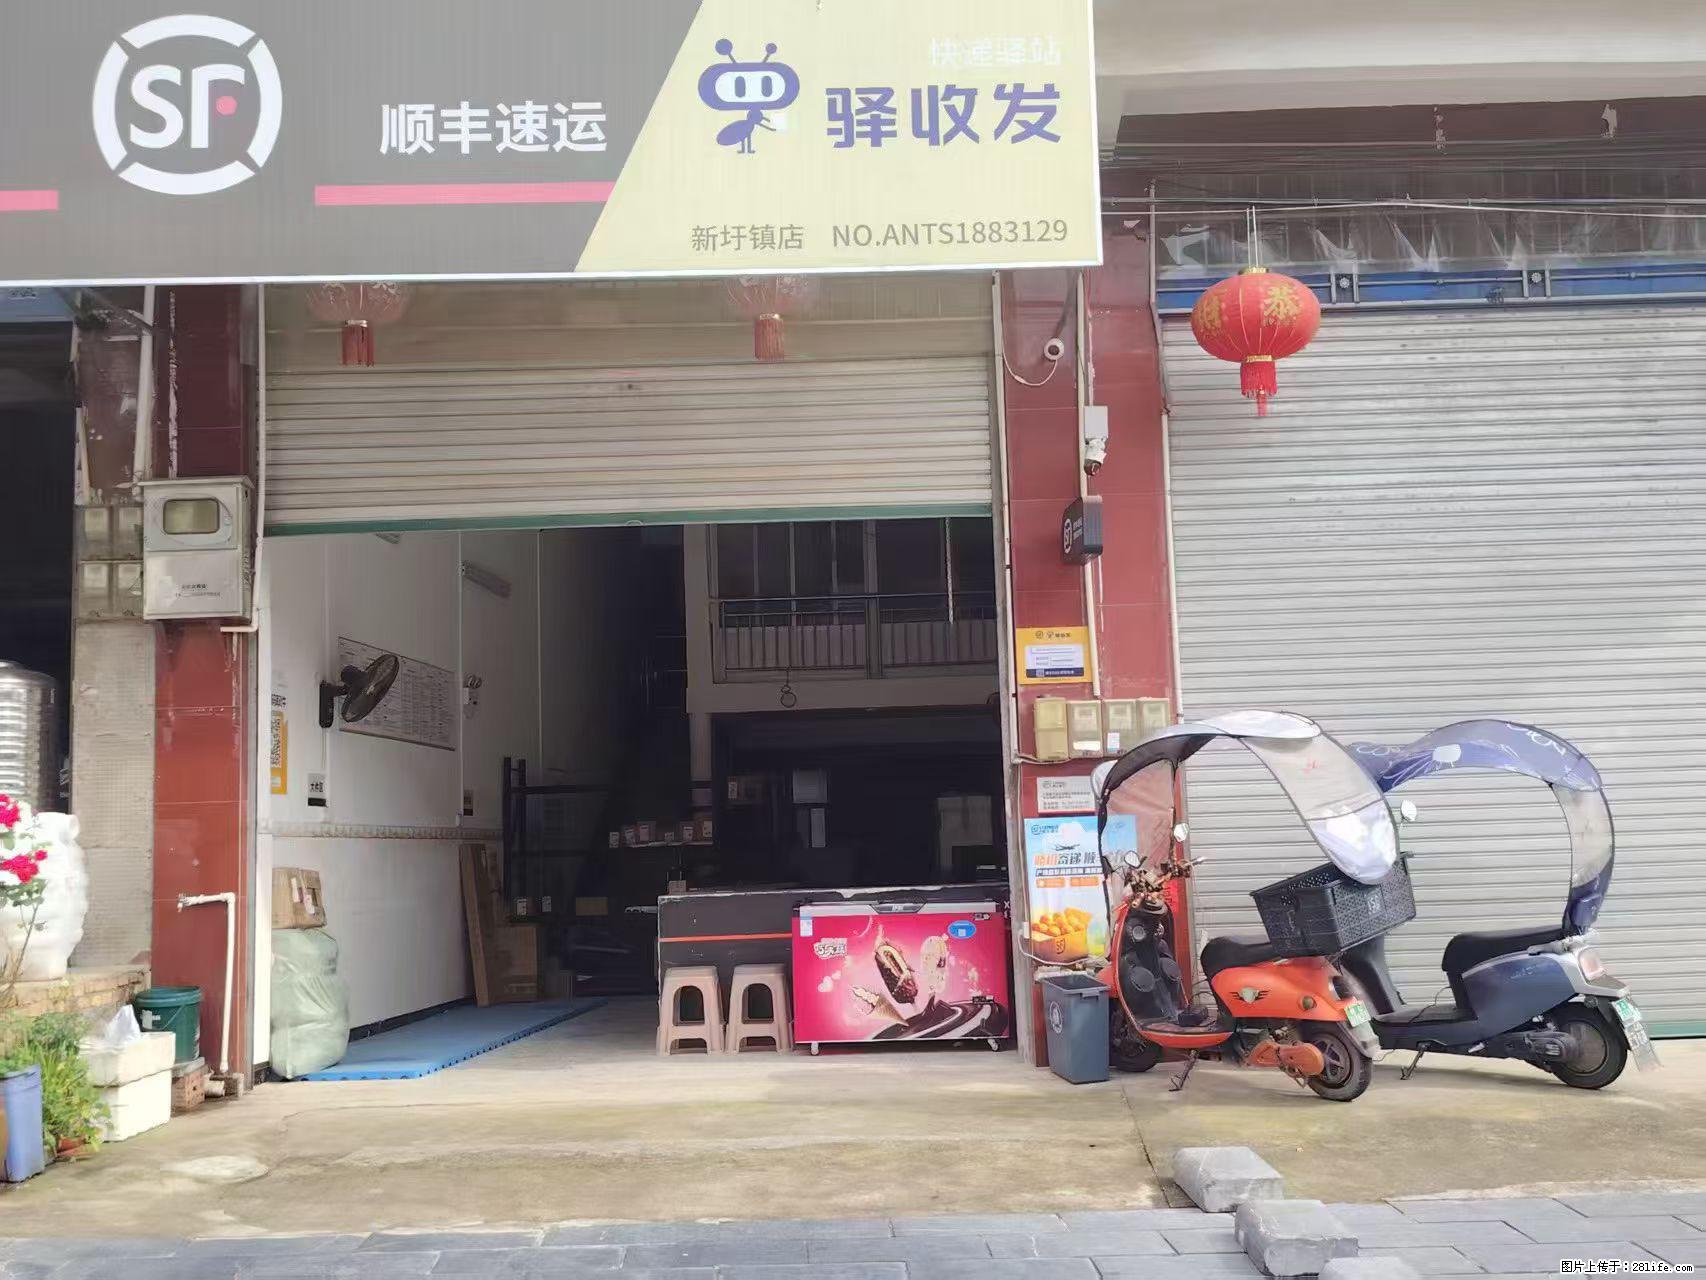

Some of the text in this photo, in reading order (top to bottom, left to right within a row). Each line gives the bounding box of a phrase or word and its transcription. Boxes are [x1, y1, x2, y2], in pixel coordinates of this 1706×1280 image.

[379, 101, 607, 155] 顺丰速运
[826, 83, 1061, 149] 驿收发
[691, 219, 1069, 252] 新圩镇店 NO.ANTS1883129
